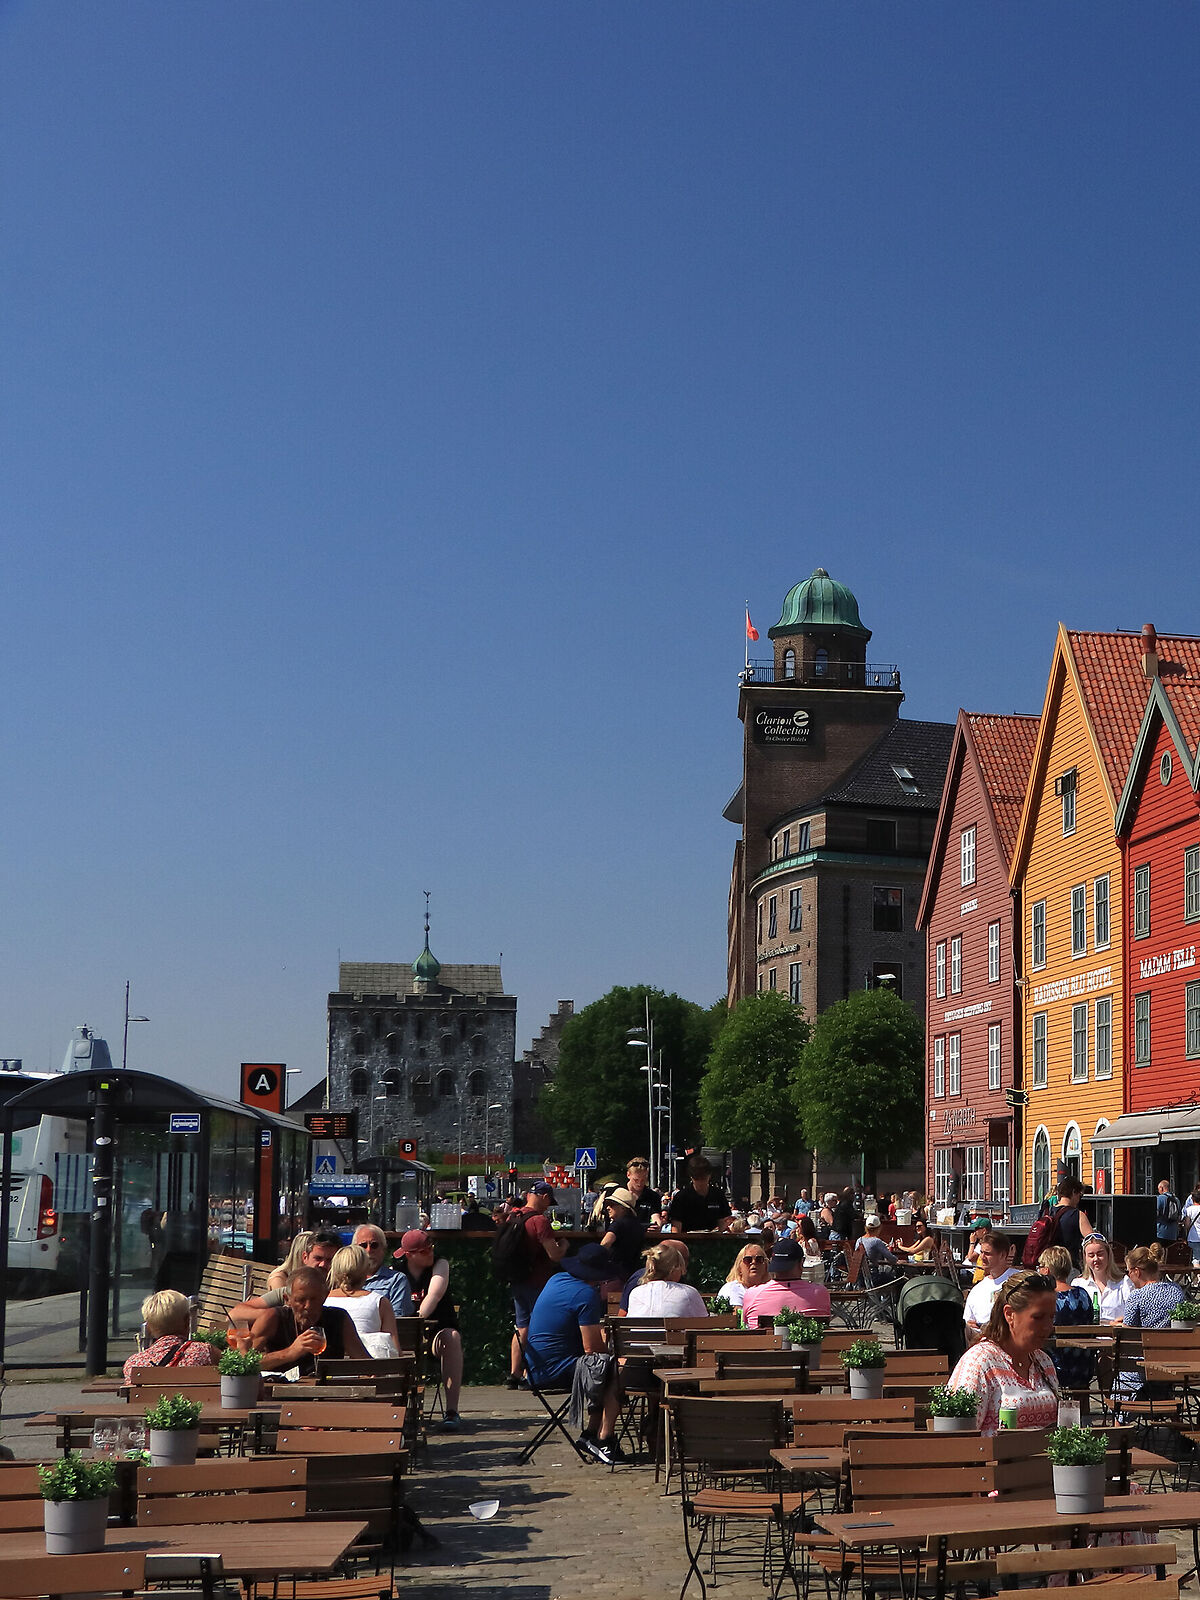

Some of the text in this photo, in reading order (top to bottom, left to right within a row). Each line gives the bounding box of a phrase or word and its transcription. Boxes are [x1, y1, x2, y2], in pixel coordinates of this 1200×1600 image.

[756, 711, 792, 725] Clarion
[764, 725, 810, 735] Collection
[1139, 953, 1171, 980] MADAM
[255, 1074, 271, 1090] A
[405, 1143, 412, 1152] B
